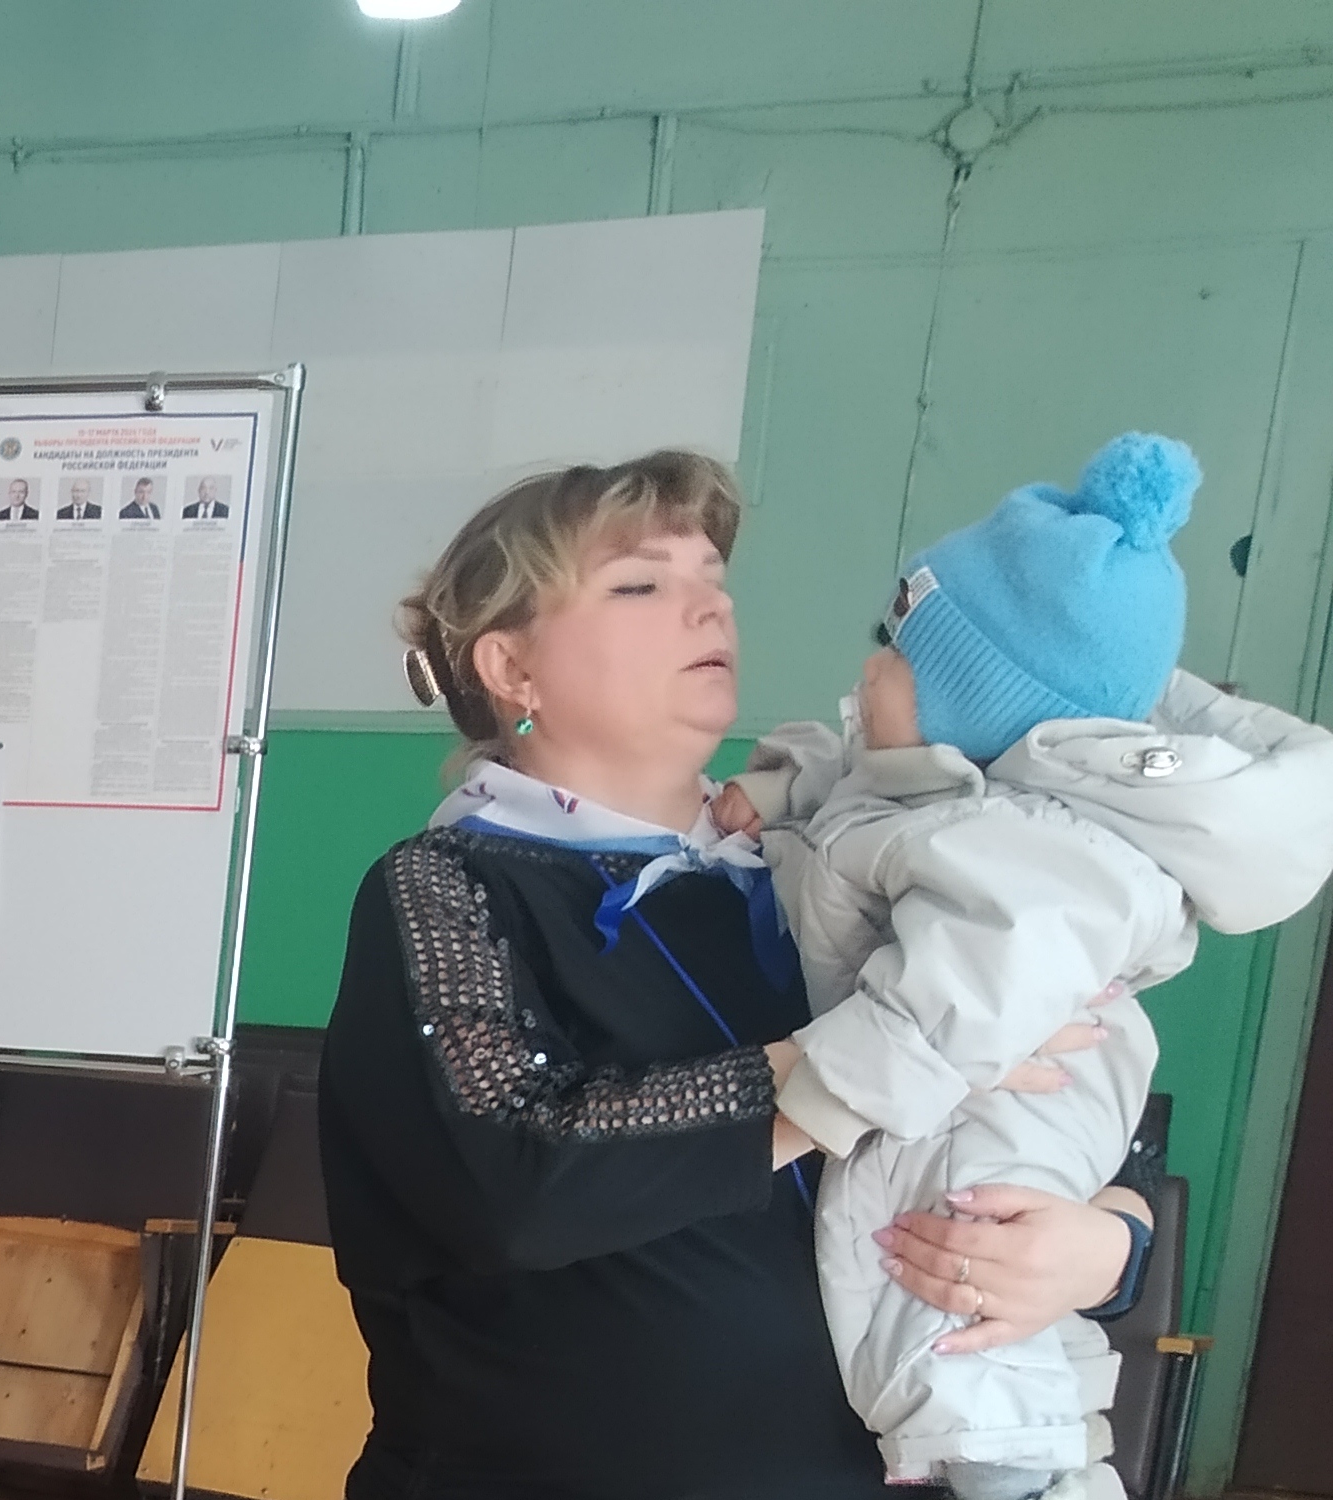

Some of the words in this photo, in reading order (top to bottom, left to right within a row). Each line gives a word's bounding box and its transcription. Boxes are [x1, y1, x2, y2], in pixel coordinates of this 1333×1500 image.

[33, 450, 82, 460] КАНДИДАТЫ
[83, 450, 94, 458] НА
[95, 449, 145, 459] ДОЛЖНОСТЬ
[147, 448, 199, 458] ПРЕЗИДЕНТА
[61, 460, 116, 470] РОССИЙСКОЙ
[117, 460, 168, 471] ФЕДЕРАЦИИ
